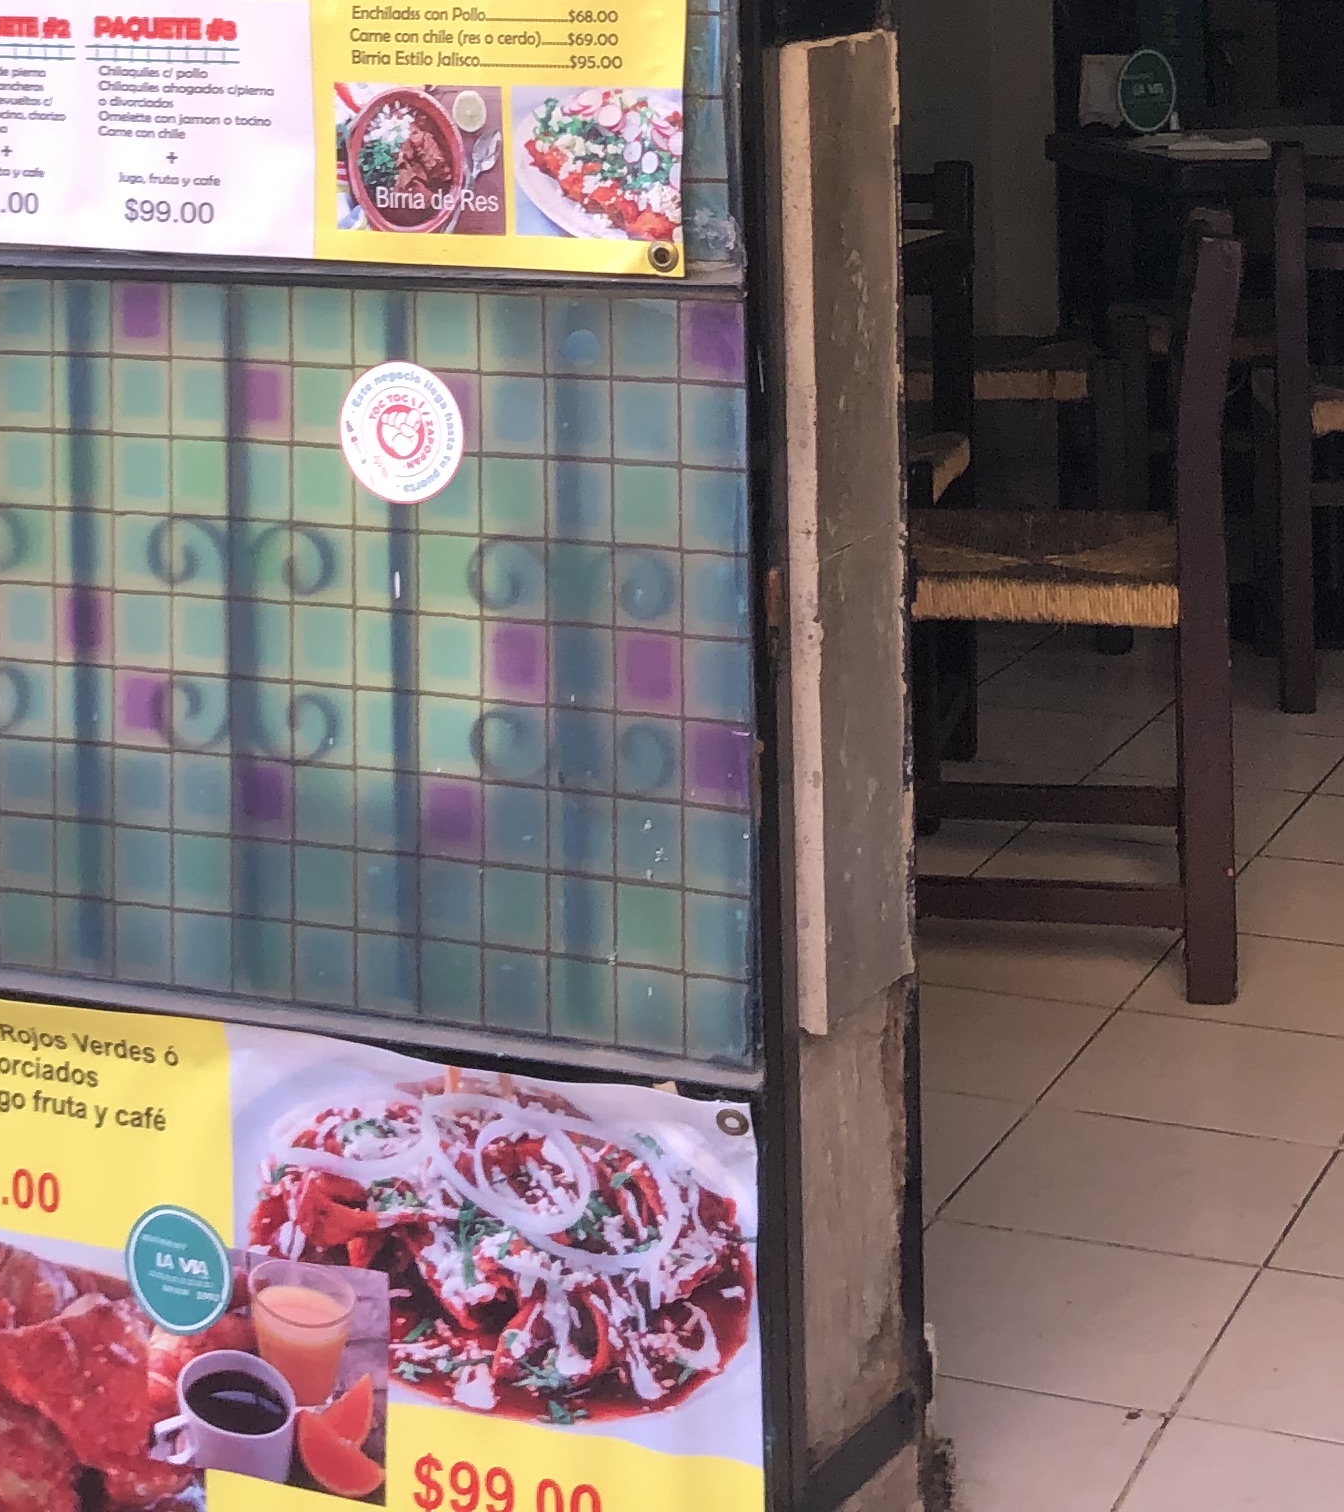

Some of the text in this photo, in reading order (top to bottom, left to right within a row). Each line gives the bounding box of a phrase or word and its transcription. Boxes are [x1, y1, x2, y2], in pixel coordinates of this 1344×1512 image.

[424, 8, 448, 21] con
[453, 7, 486, 22] Pollo
[568, 9, 618, 24] $68.00
[42, 17, 71, 39] #2
[94, 15, 202, 41] PAQUETE
[349, 28, 618, 47] Carne con chile (res o cerdo) $69.00
[351, 49, 623, 70] Birria Estilo Jalisco $95.00
[98, 65, 160, 78] Chilaquiles
[176, 68, 208, 80] pollo
[98, 98, 107, 106] o
[98, 110, 151, 123] Omelette
[154, 114, 176, 124] con
[223, 117, 232, 125] o
[235, 115, 271, 126] tocino
[98, 125, 186, 139] Carne con chile
[124, 198, 214, 223] $99.00
[376, 186, 499, 212] Birria de Res
[369, 394, 408, 419] TOC TOC
[71, 1032, 157, 1064] Verdes
[164, 1045, 179, 1067] ó
[33, 1090, 87, 1119] fruta
[94, 1105, 109, 1128] y
[115, 1107, 167, 1131] café
[156, 1252, 210, 1276] LA VIA
[412, 1453, 602, 1512] $9900
